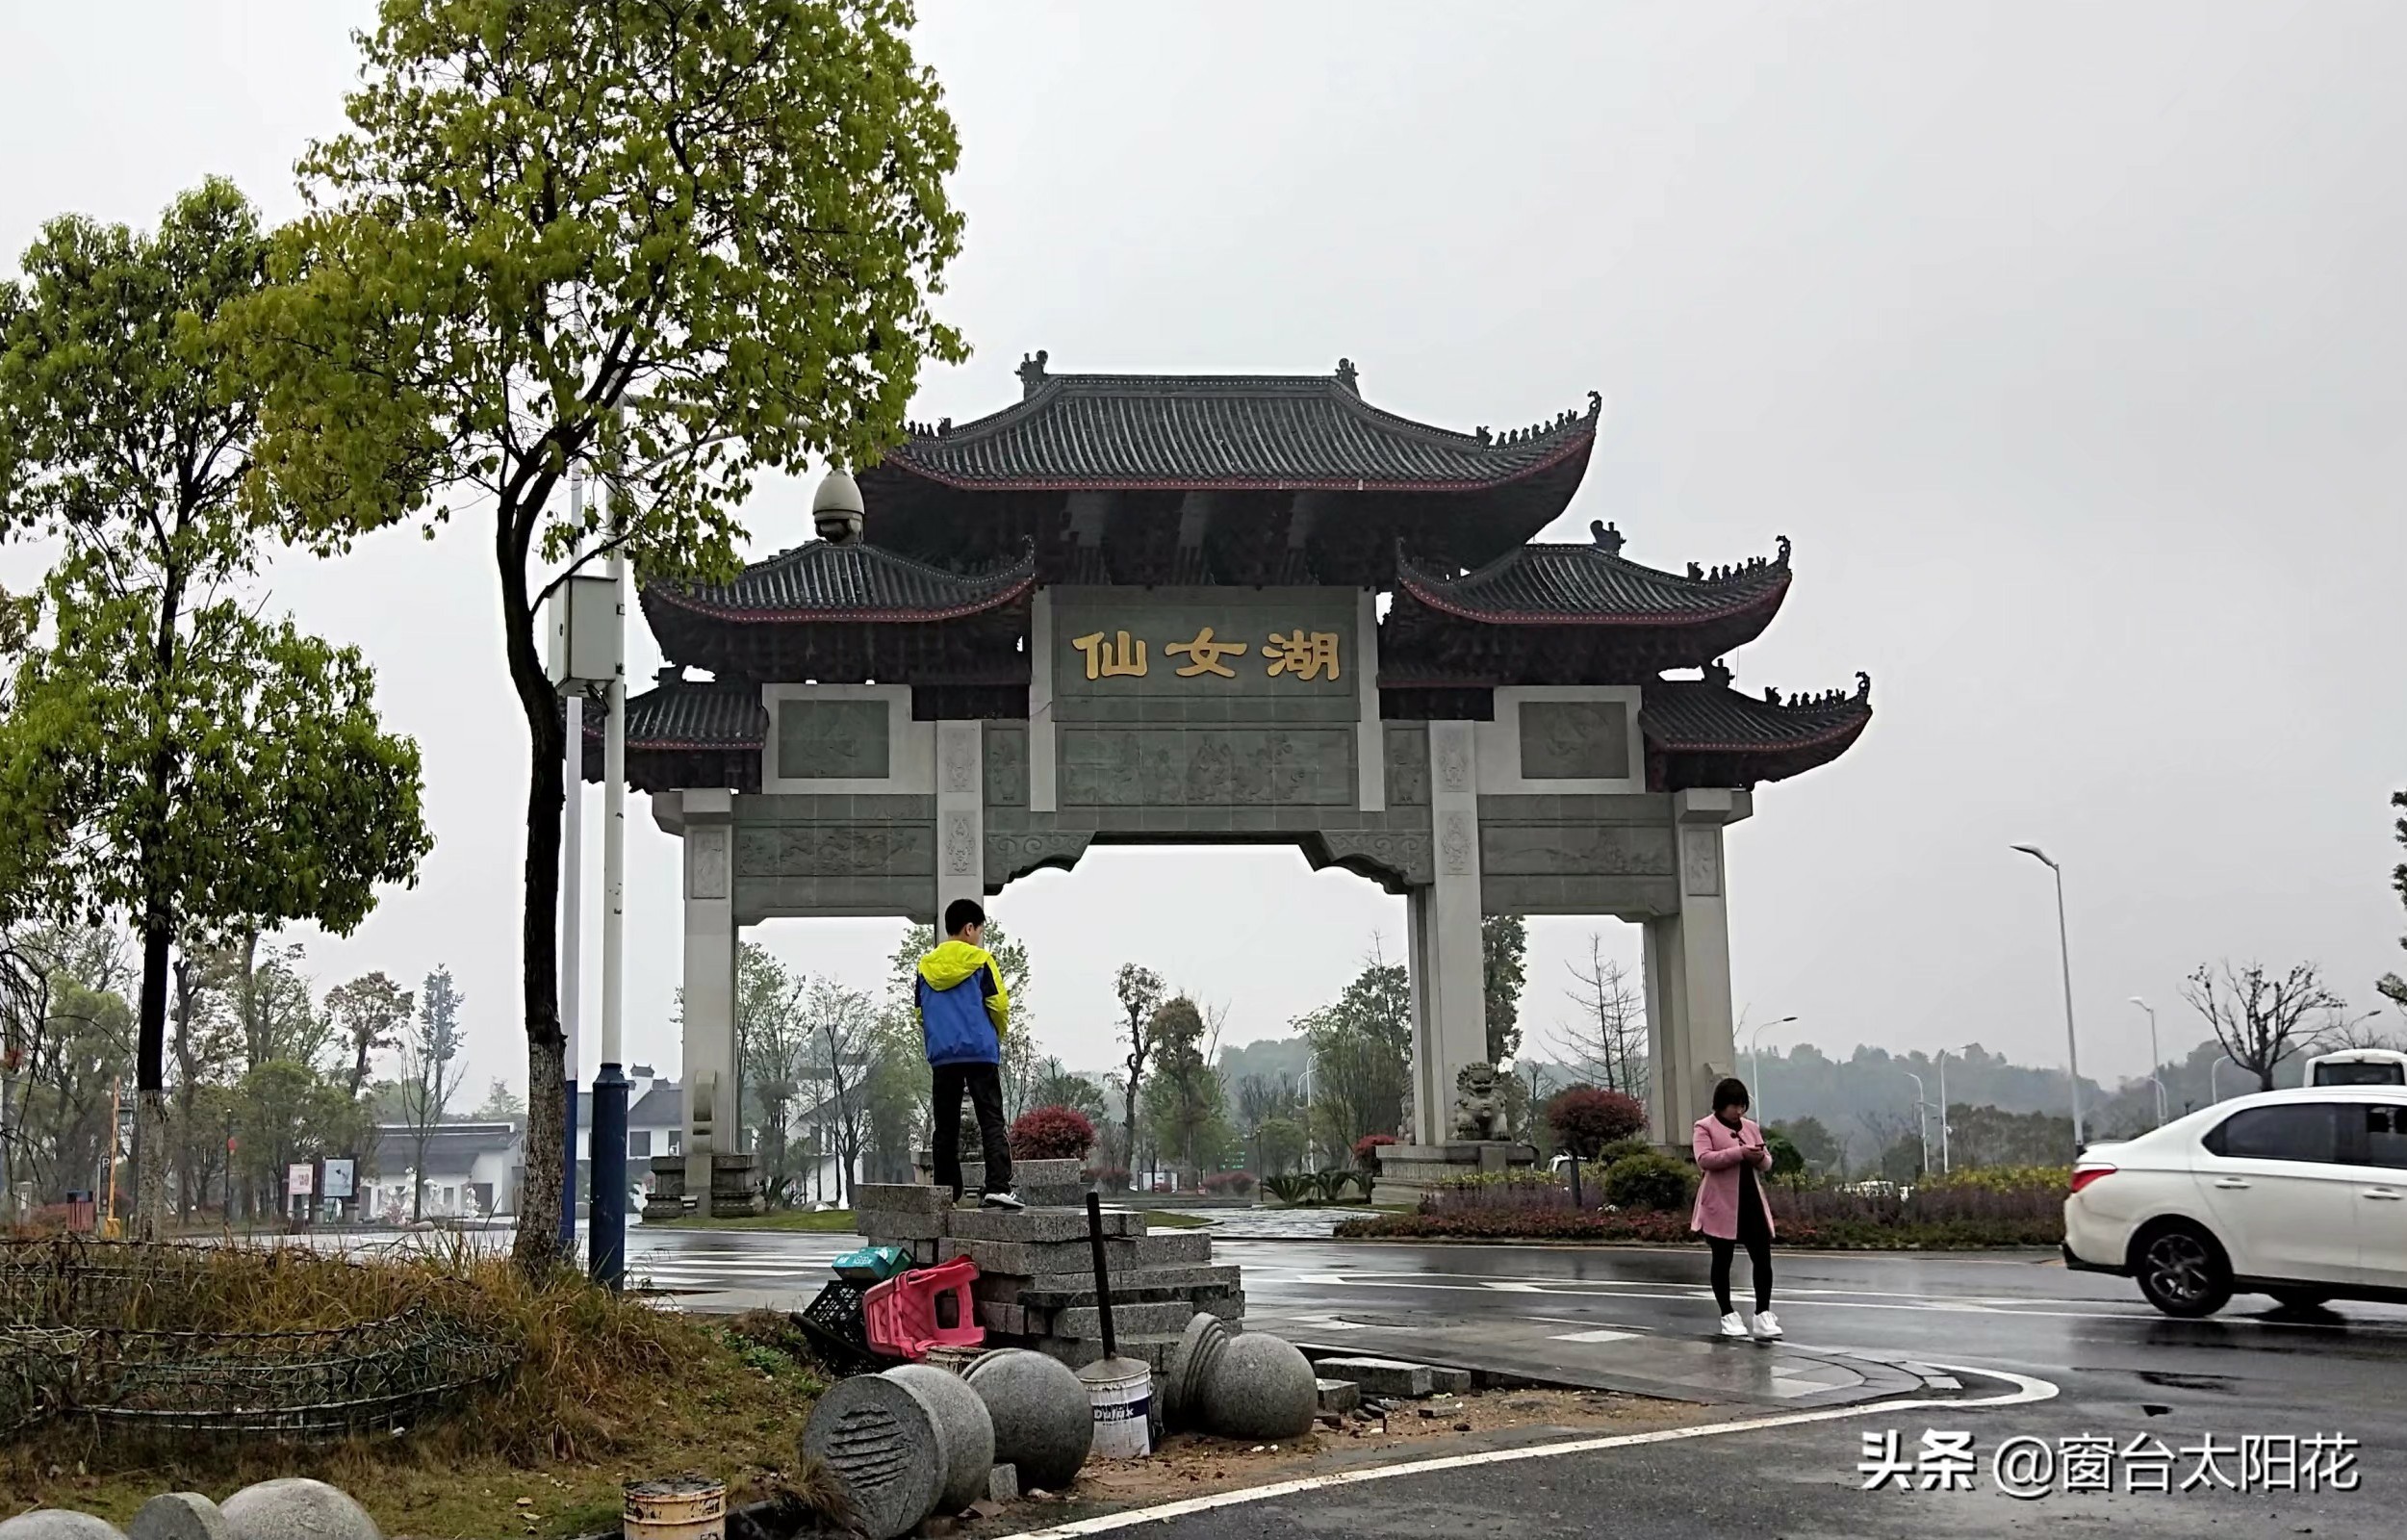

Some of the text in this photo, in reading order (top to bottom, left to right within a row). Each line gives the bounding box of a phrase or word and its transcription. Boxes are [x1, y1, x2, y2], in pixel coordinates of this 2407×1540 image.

[1072, 627, 1340, 680] 仙女湖
[102, 1158, 111, 1168] P
